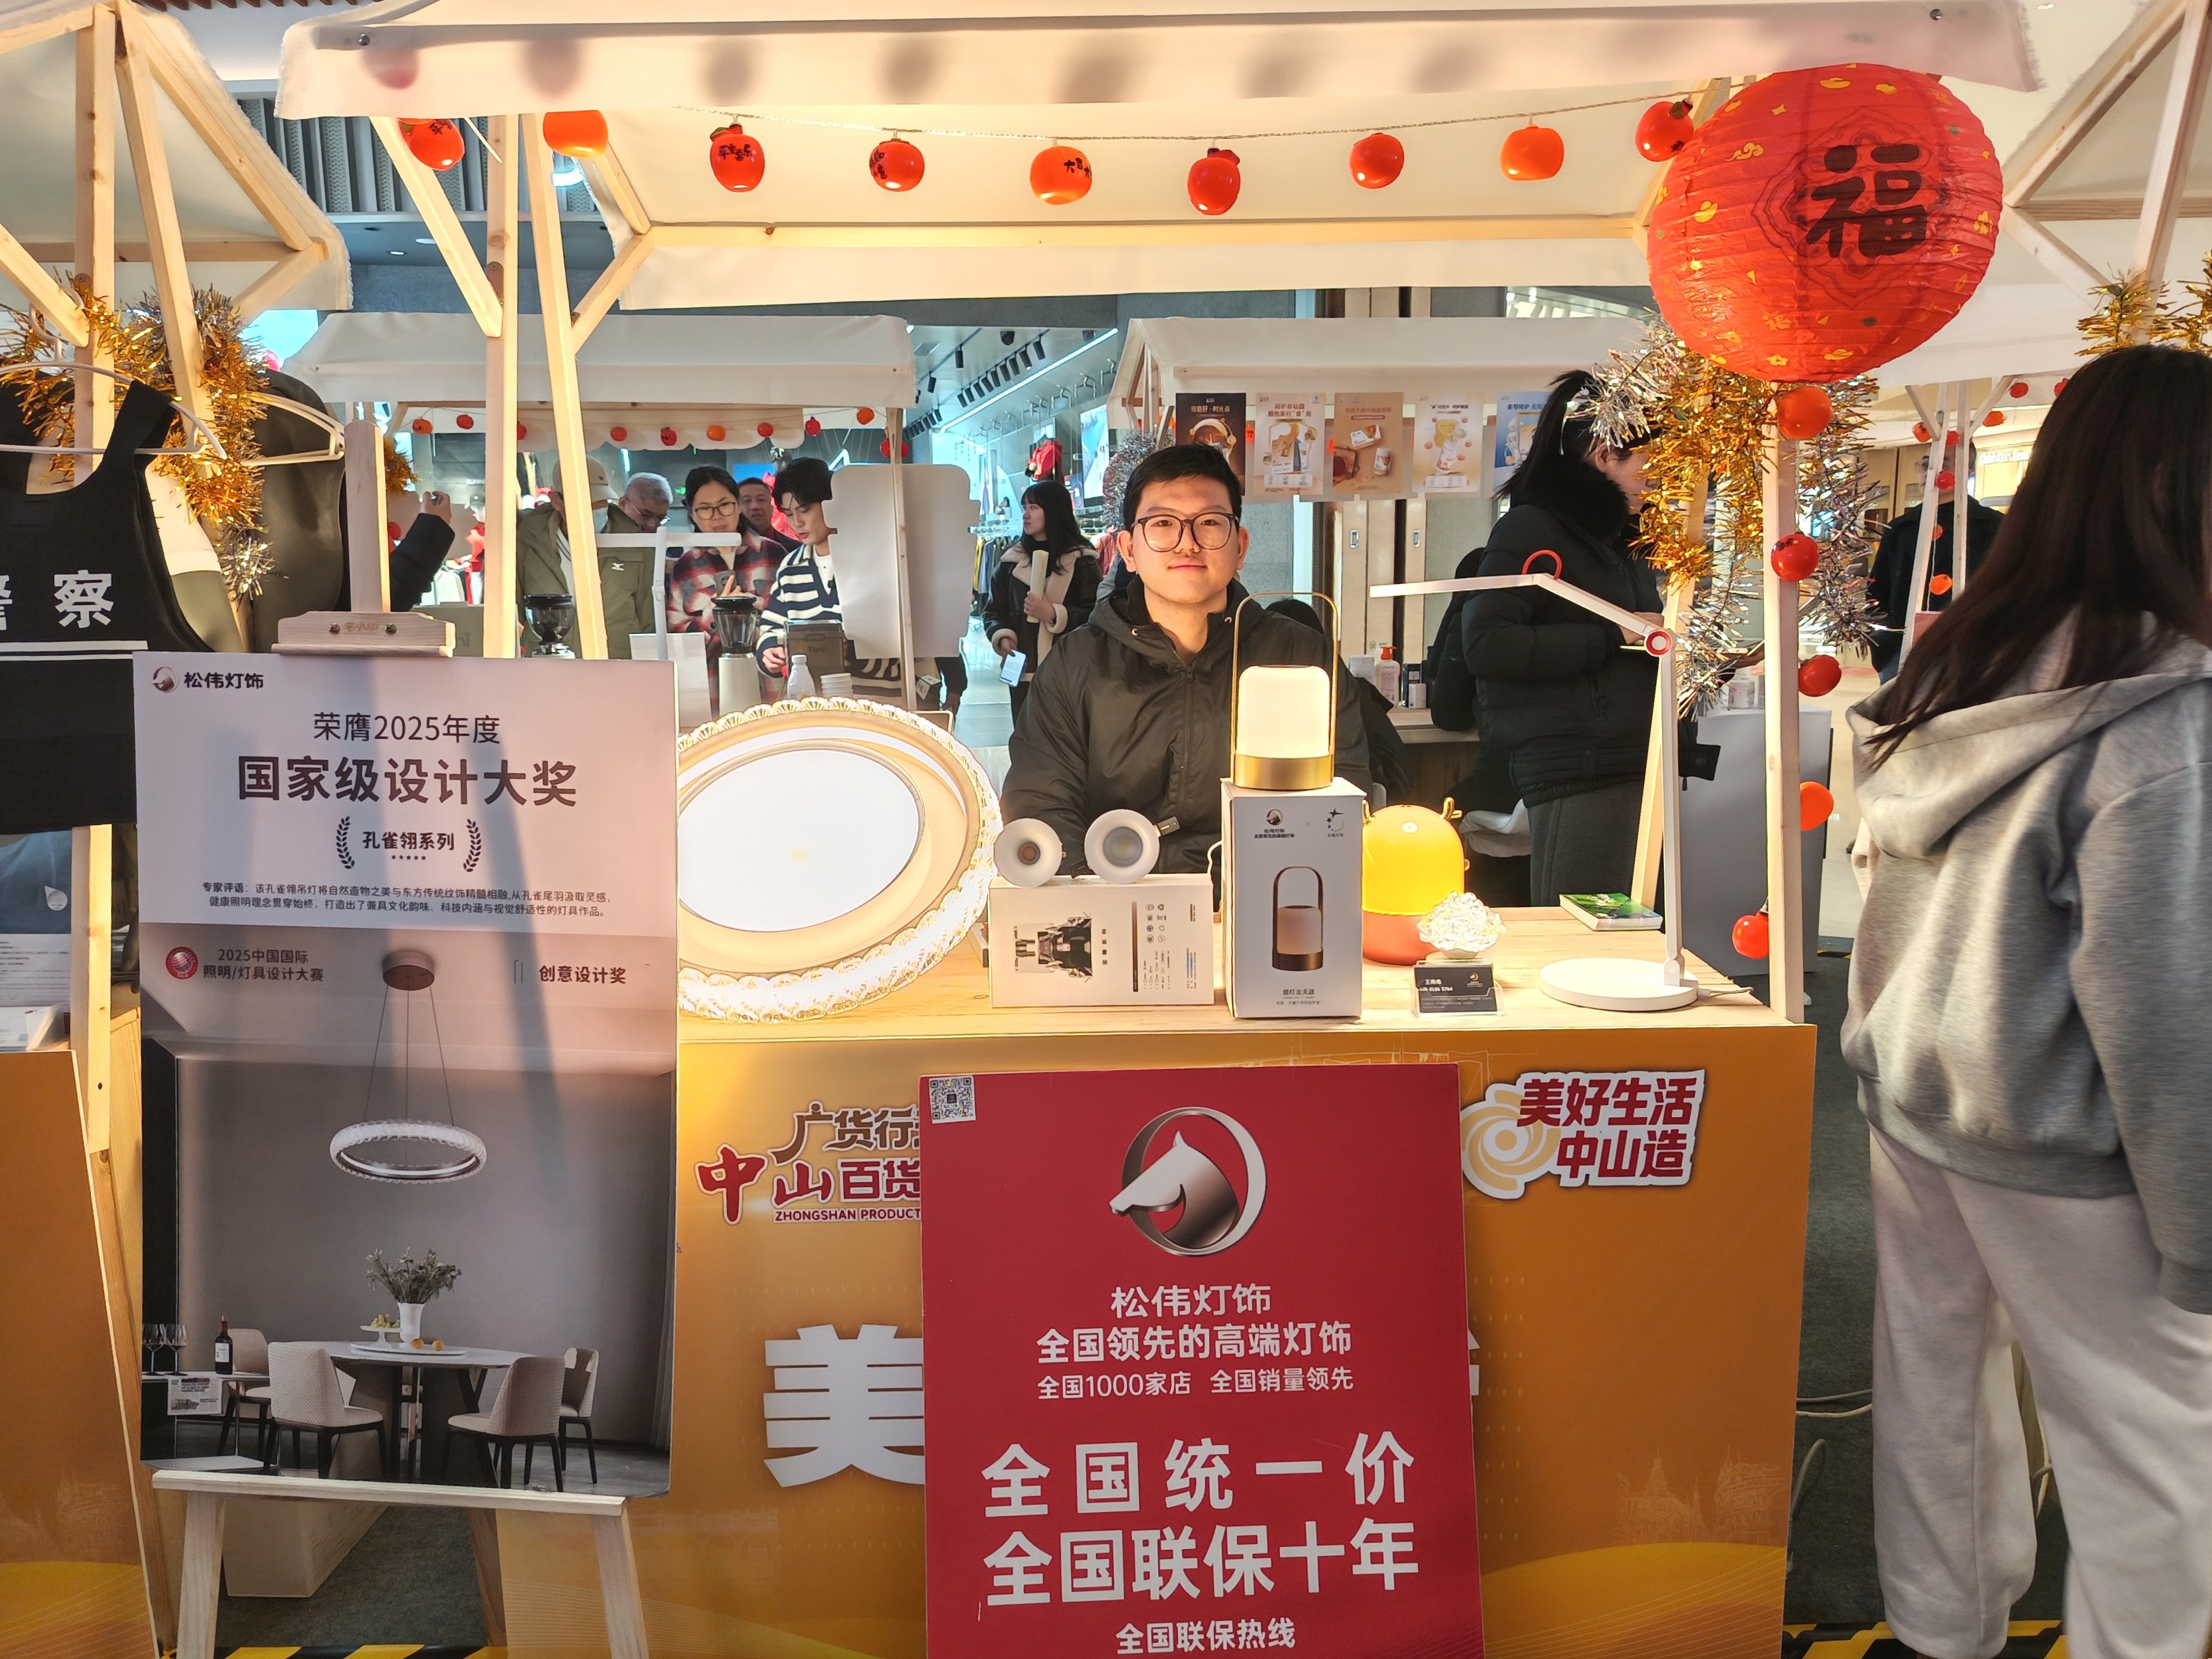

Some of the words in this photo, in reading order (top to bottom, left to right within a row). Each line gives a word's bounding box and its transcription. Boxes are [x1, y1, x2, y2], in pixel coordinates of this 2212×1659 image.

[1063, 157, 1091, 179] 大吉大
[1805, 143, 1928, 258] 福
[0, 569, 115, 630] 察
[184, 672, 264, 689] 松伟灯饰
[313, 712, 501, 744] 荣膺2025年度
[238, 755, 577, 807] 国家级设计大奖
[362, 830, 455, 851] 孔雀翎系列
[203, 965, 324, 982] 照明/灯具设计大赛
[218, 949, 309, 964] 2025中国国际
[539, 965, 626, 984] 创意设计奖
[1516, 1077, 1697, 1127] 美好生活
[771, 1103, 919, 1164] 广货行
[1556, 1129, 1687, 1178] 中山造
[775, 1210, 856, 1222] ZHONGSHAN
[1110, 1283, 1272, 1319] 松伟灯饰
[1037, 1321, 1352, 1364] 全国领先的高端灯饰
[1037, 1371, 1192, 1399] 全国1000家店
[1210, 1366, 1354, 1394] 全国销量领先
[763, 1324, 925, 1488] 美
[981, 1431, 1415, 1517] 全国统一价
[983, 1517, 1419, 1606] 全国联保十年
[1116, 1617, 1296, 1655] 全国联保热线
